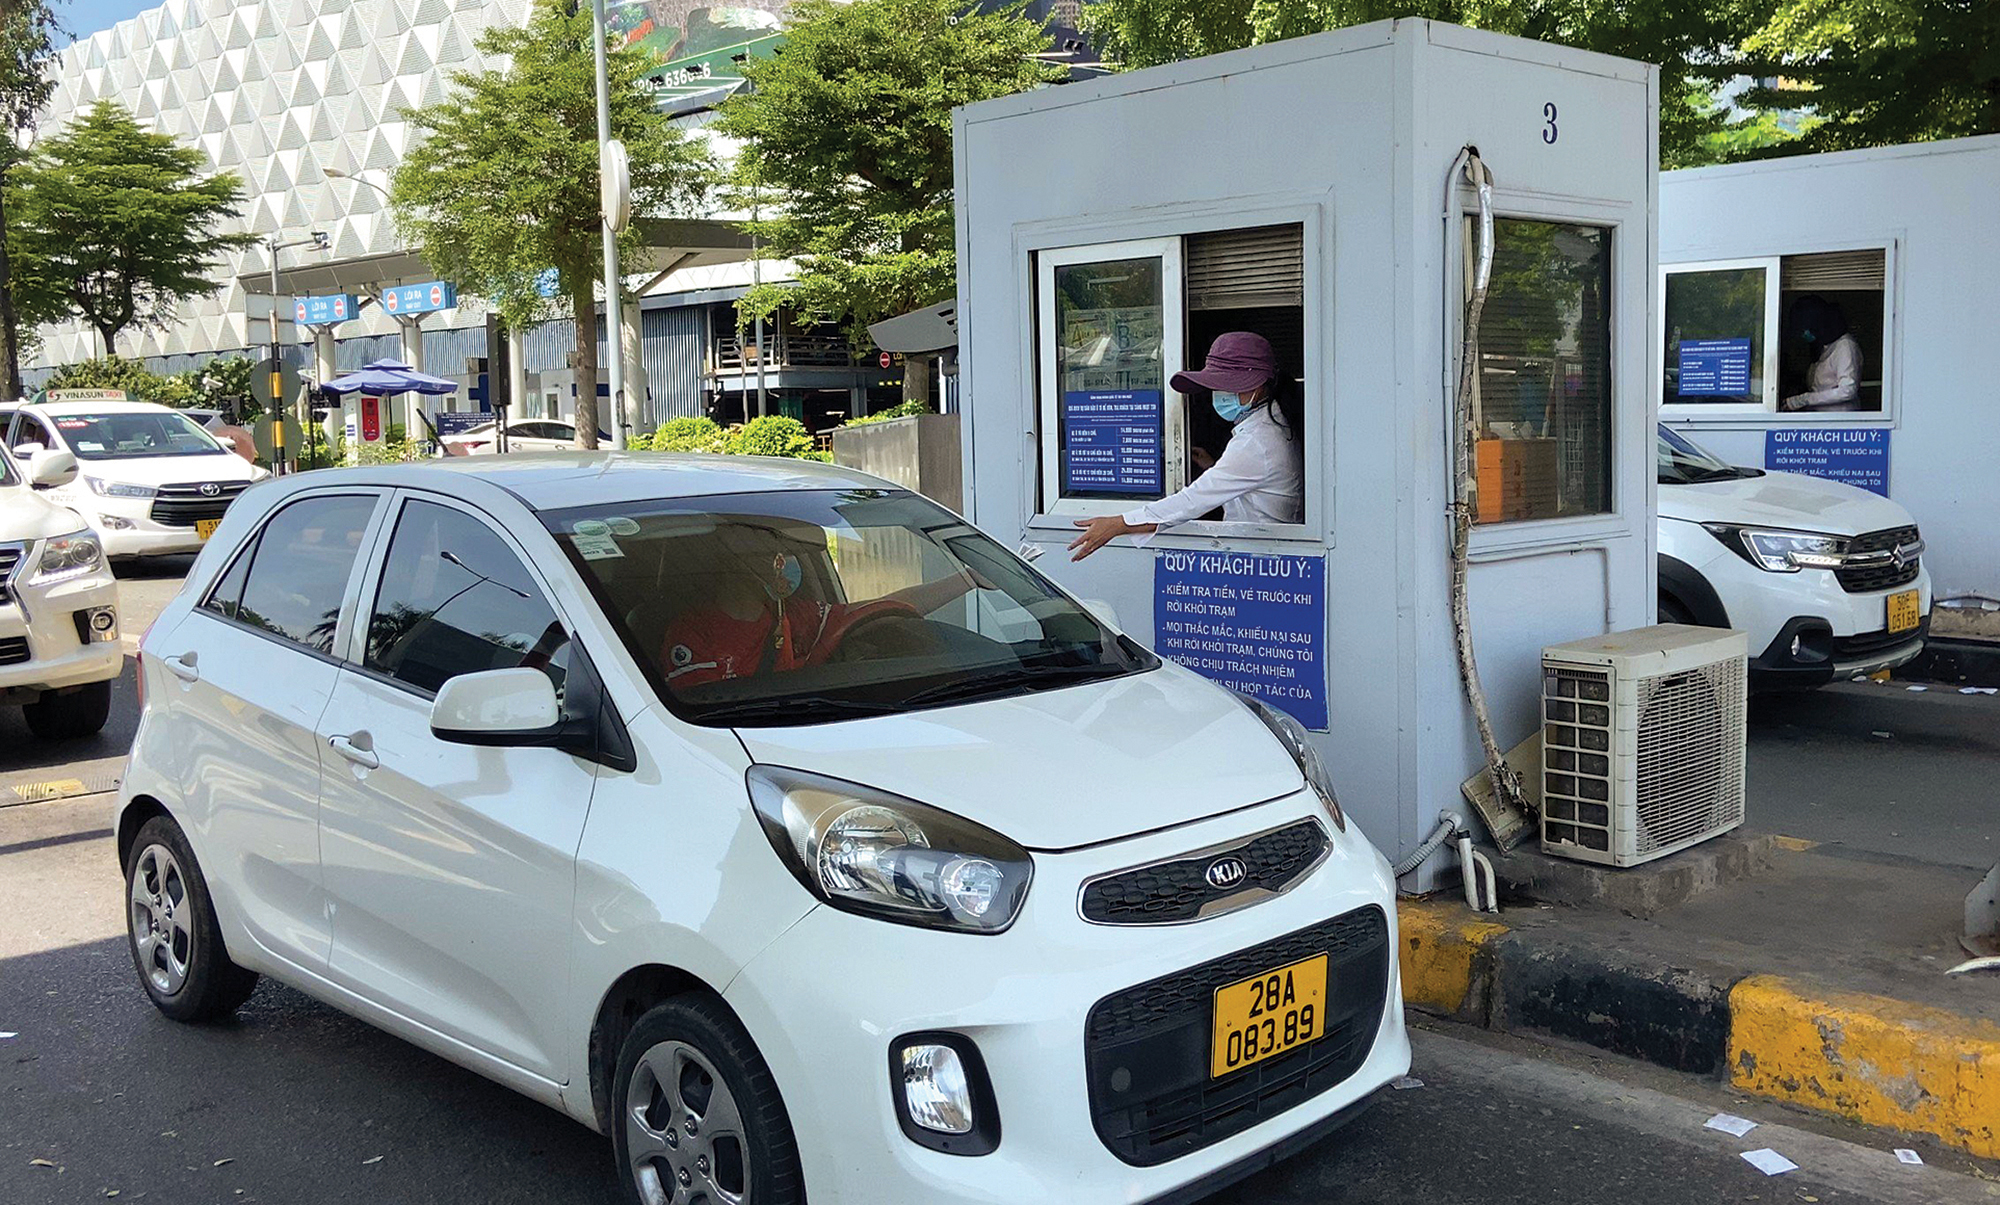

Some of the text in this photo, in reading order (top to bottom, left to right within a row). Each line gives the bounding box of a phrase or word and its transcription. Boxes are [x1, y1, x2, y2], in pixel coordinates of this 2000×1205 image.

[1543, 102, 1558, 144] 3
[1774, 430, 1798, 442] QUÝ
[1801, 430, 1840, 442] KHÁCH
[1844, 430, 1866, 442] LƯU
[1165, 552, 1311, 578] QUÝ KHÁCH LƯU Ý:
[1166, 581, 1190, 596] KIỂM
[1192, 585, 1211, 598] TRA
[1240, 587, 1253, 600] VÉ
[1256, 589, 1291, 603] TRƯỚC
[1294, 594, 1311, 605] KHI
[1184, 600, 1206, 614] KHỎI
[1209, 605, 1236, 618] TRẠM
[1166, 621, 1311, 645] MỌI THẮC MẮC, KHIẾU NẠI SAU
[1167, 638, 1182, 648] KHI
[1202, 640, 1224, 653] KHỎI
[1226, 643, 1255, 657] TRẠM,
[1258, 646, 1294, 660] CHÚNG
[1296, 650, 1313, 662] TÔI
[1202, 658, 1224, 672] CHỊU
[1226, 660, 1260, 675] TRÁCH
[1262, 664, 1295, 678] NHIỆM
[1265, 682, 1286, 696] TÁC
[1289, 685, 1312, 699] CỦA
[1212, 861, 1243, 884] KIA
[1249, 970, 1295, 1018] 28A
[1226, 1004, 1314, 1068] 083.89
